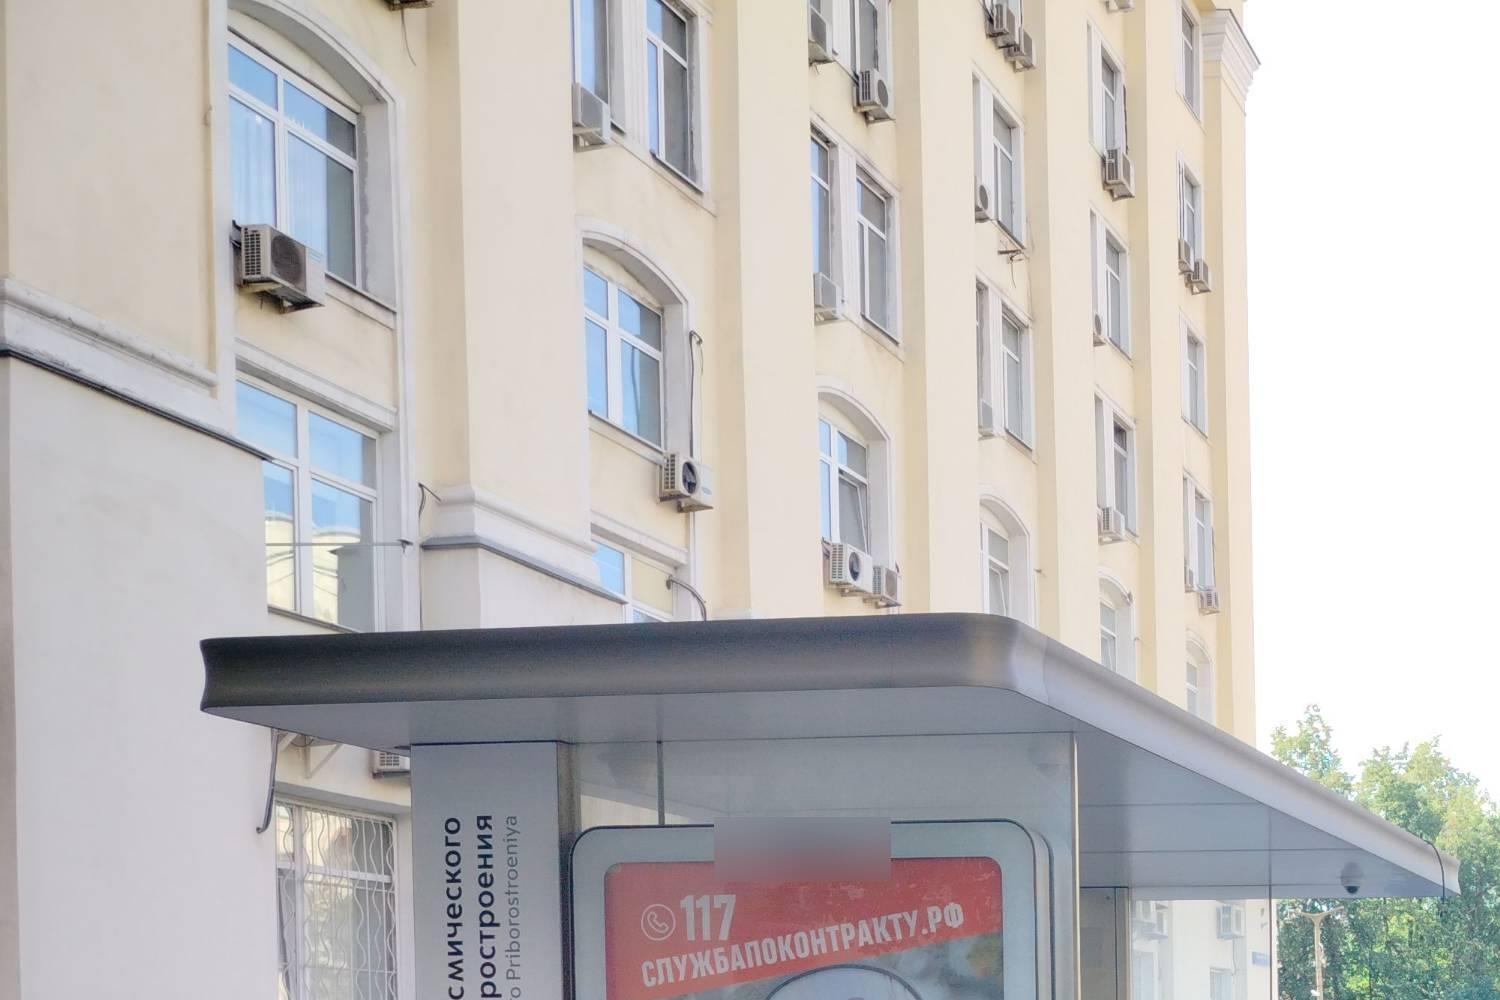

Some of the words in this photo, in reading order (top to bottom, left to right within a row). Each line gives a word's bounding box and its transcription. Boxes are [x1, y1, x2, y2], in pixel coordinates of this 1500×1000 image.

[502, 815, 521, 980] Priborostroeniya
[680, 894, 737, 942] 117
[640, 902, 964, 988] СЛУЖБАПОКОНТРАКТУ.РФ
